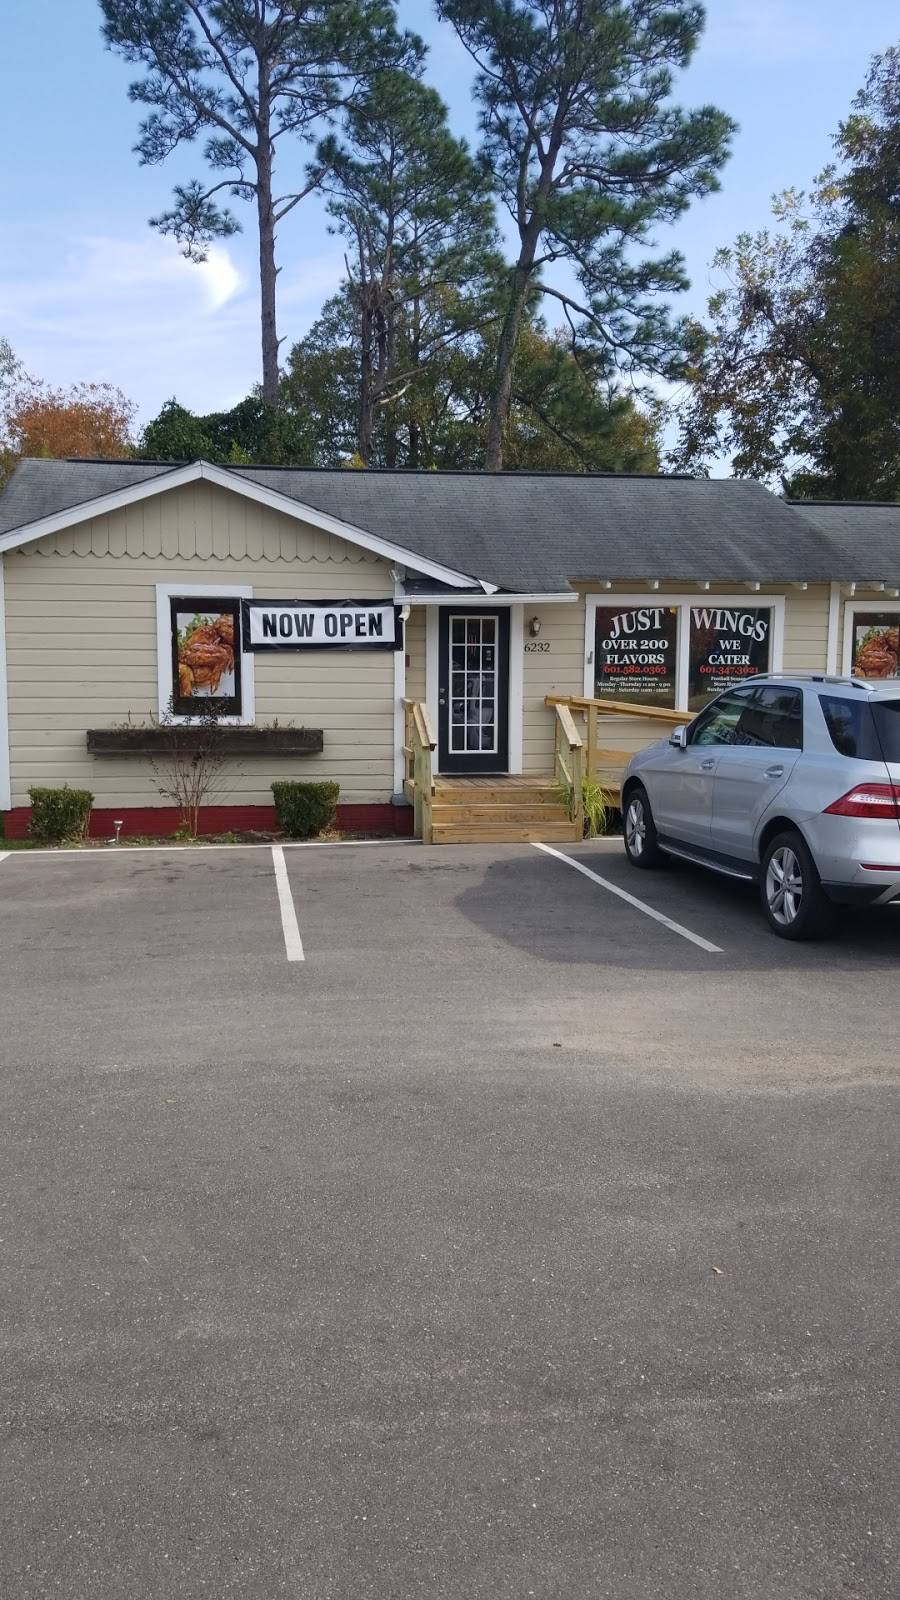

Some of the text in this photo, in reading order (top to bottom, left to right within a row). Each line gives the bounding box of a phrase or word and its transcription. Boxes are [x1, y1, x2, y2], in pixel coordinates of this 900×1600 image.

[262, 613, 383, 637] NOW OPEN
[609, 608, 768, 641] JUST WINGS
[524, 642, 550, 653] 6232
[602, 639, 669, 650] OVER 200
[719, 639, 741, 650] WE
[606, 654, 665, 665] FLAVORS
[708, 655, 751, 665] CATER
[603, 665, 667, 674] 601.582.0363
